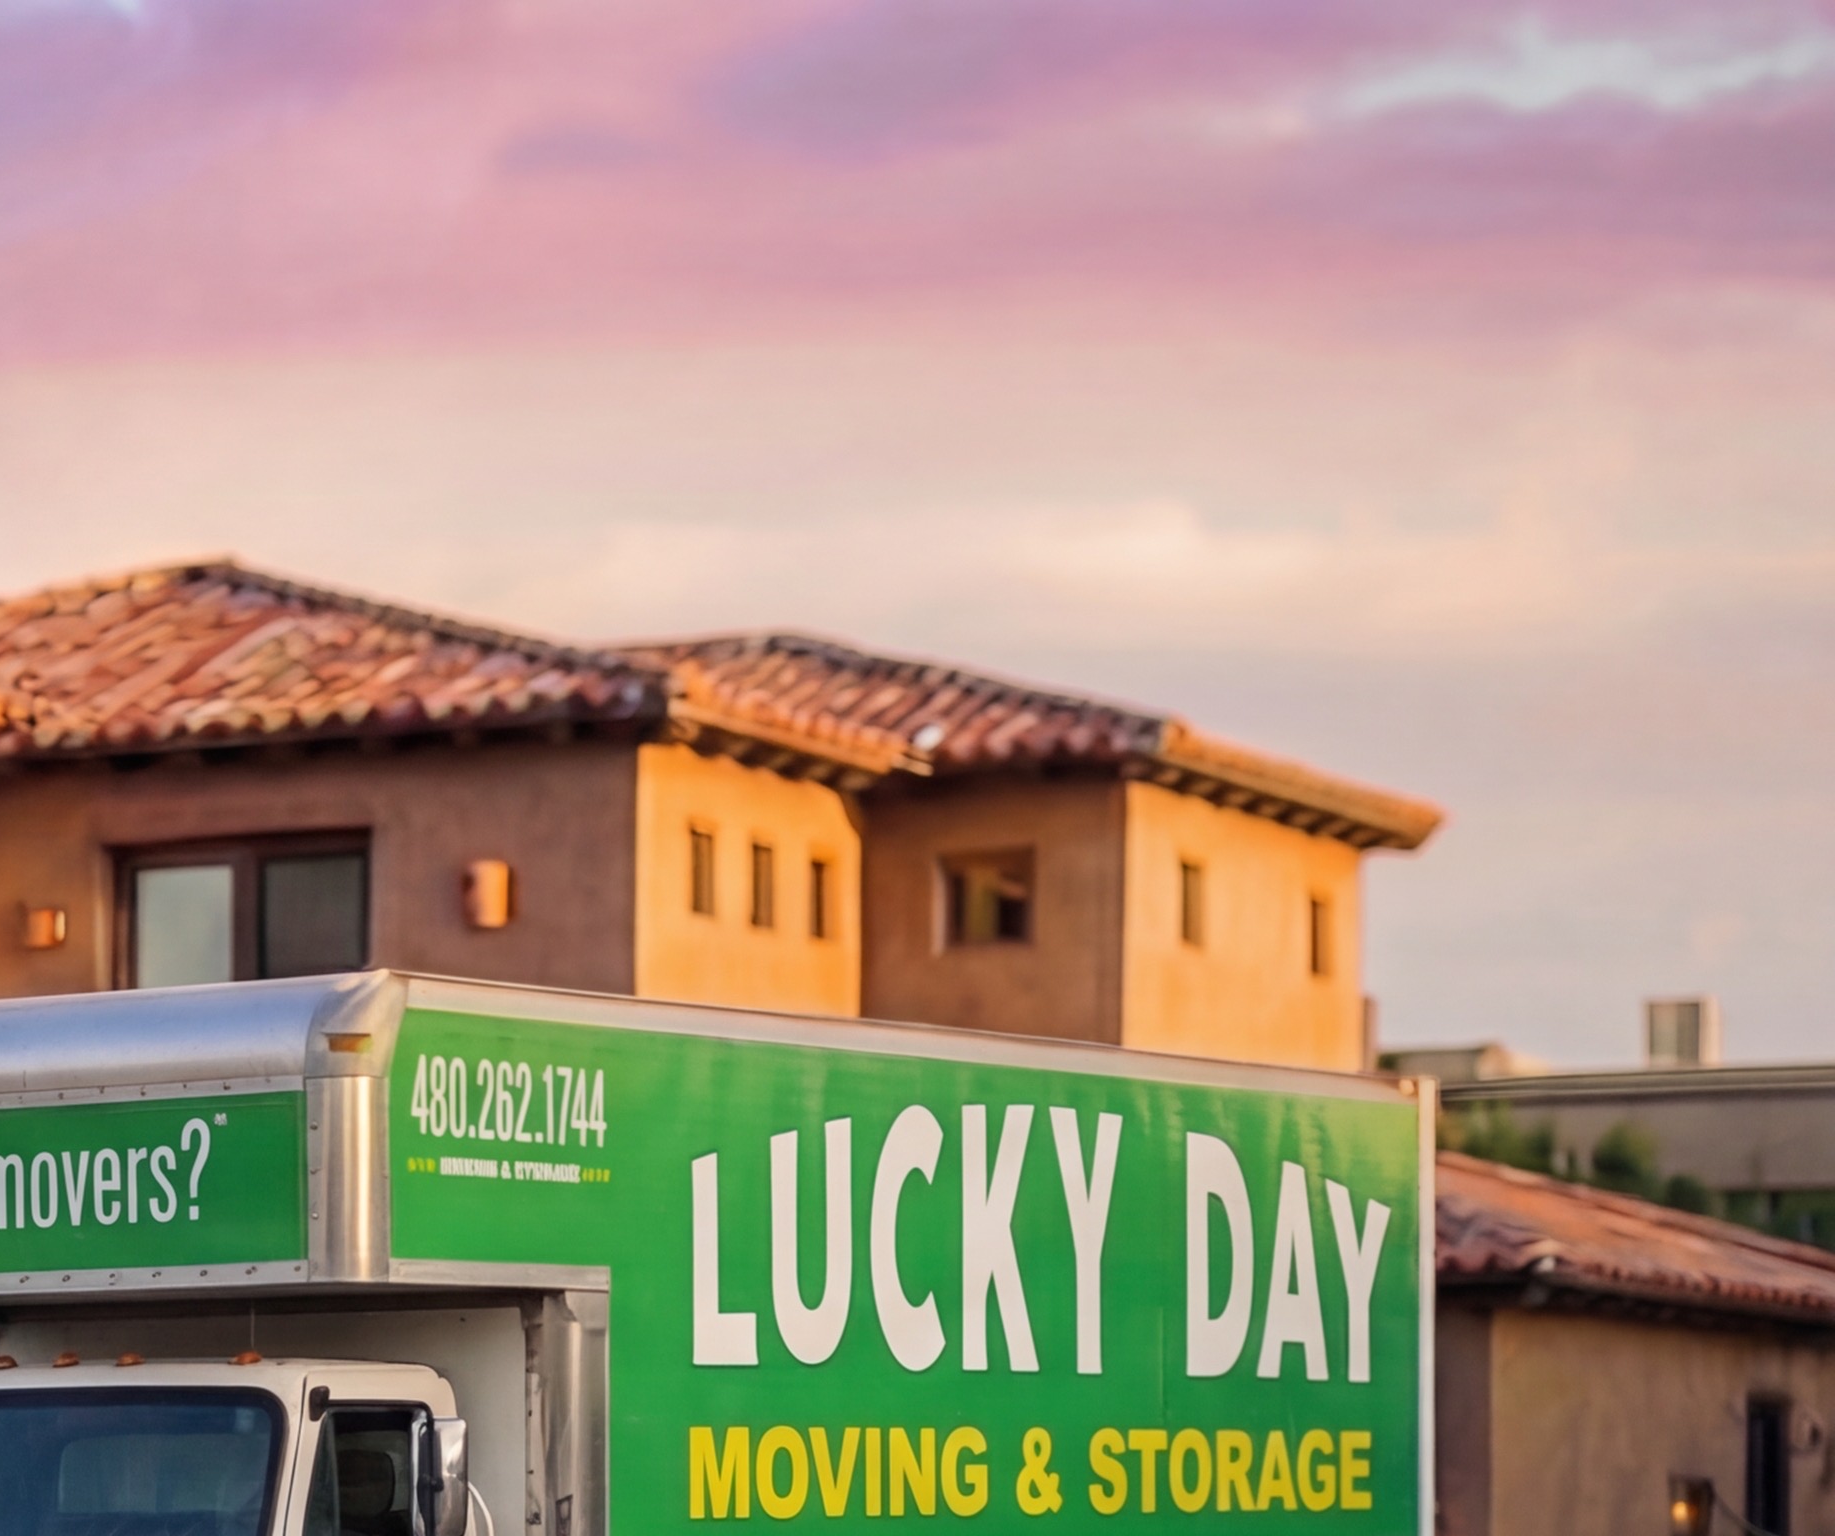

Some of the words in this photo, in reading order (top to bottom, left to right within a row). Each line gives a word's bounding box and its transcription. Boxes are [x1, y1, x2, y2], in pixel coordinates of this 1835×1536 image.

[410, 1053, 608, 1148] 480.262.1744
[690, 1103, 1124, 1375] LUCKY
[1185, 1130, 1392, 1383] DAY
[689, 1425, 989, 1520] MOVING
[1015, 1426, 1063, 1516] &
[1088, 1427, 1373, 1515] STORAGE
